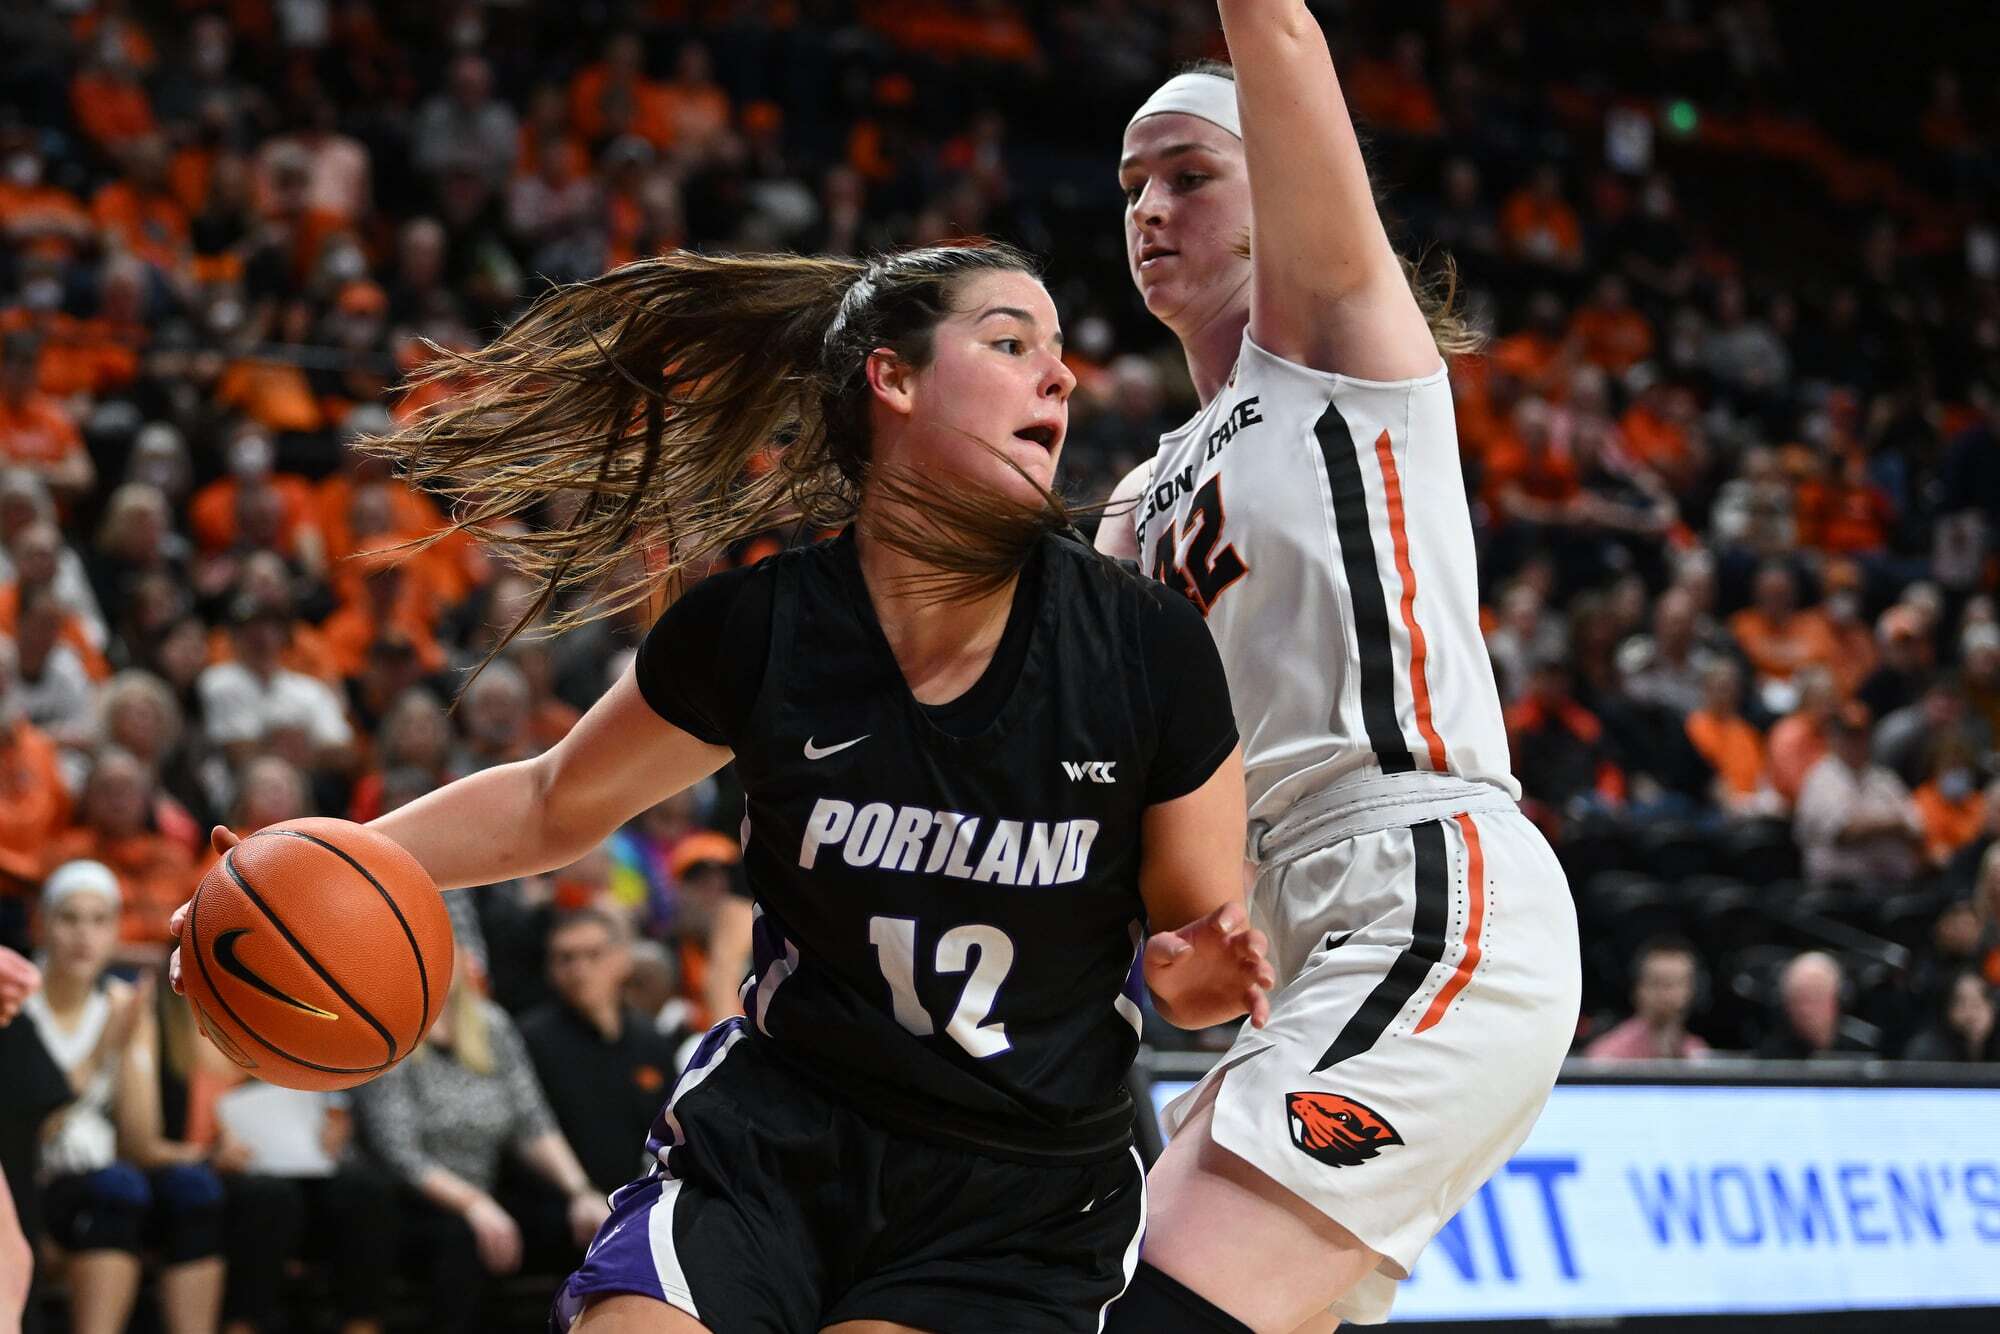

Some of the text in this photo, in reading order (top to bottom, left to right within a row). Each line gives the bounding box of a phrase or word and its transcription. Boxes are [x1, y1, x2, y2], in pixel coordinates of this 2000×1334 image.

[1207, 395, 1263, 461] TATE
[1061, 761, 1117, 783] WCC
[798, 798, 1100, 886] PORTLAND
[868, 915, 1015, 1059] 12
[1624, 1163, 2000, 1247] WOMEN'S
